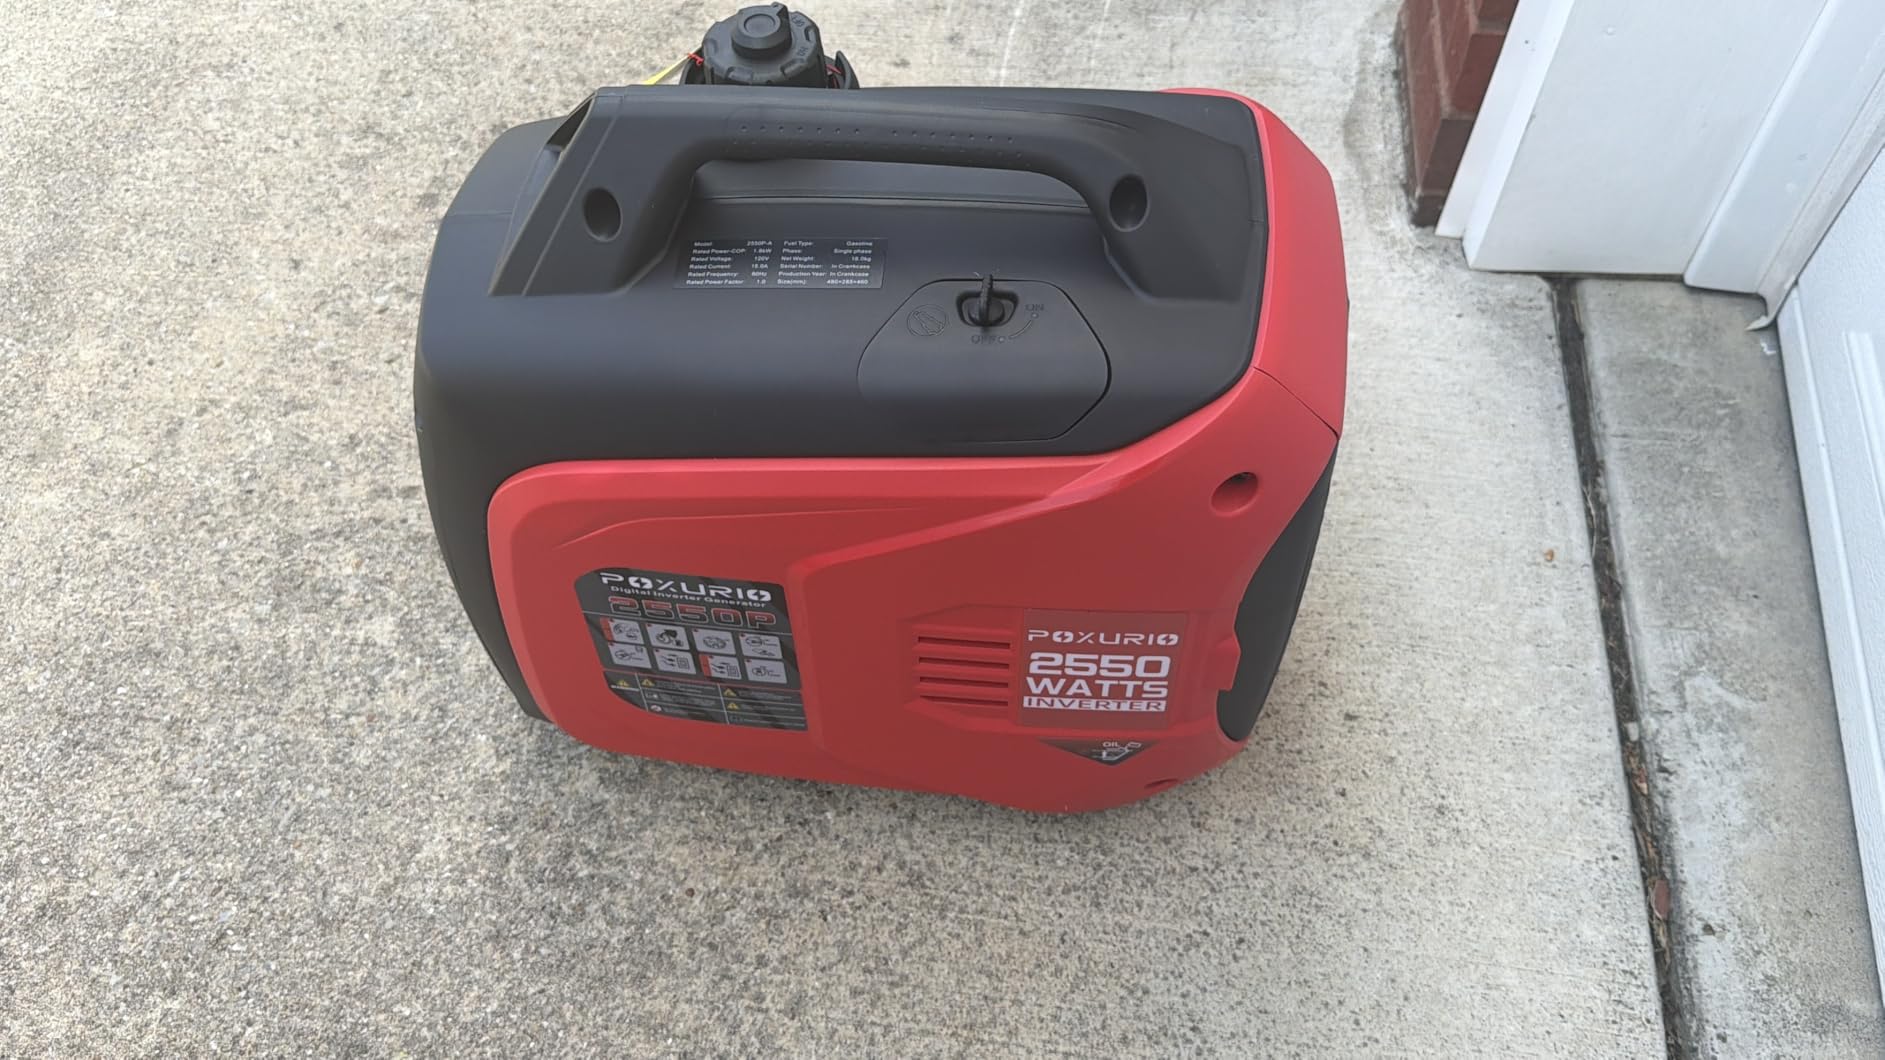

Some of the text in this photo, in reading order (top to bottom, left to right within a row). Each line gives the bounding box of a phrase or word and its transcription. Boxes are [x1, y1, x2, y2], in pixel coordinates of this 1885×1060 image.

[600, 572, 772, 602] POXURIO
[610, 585, 766, 608] Digital Inverter Generator
[608, 596, 776, 629] 2550P
[1027, 629, 1179, 646] POXURIO
[1029, 652, 1171, 678] 2550
[1026, 677, 1168, 698] WATTS
[1026, 697, 1163, 711] INVERTER
